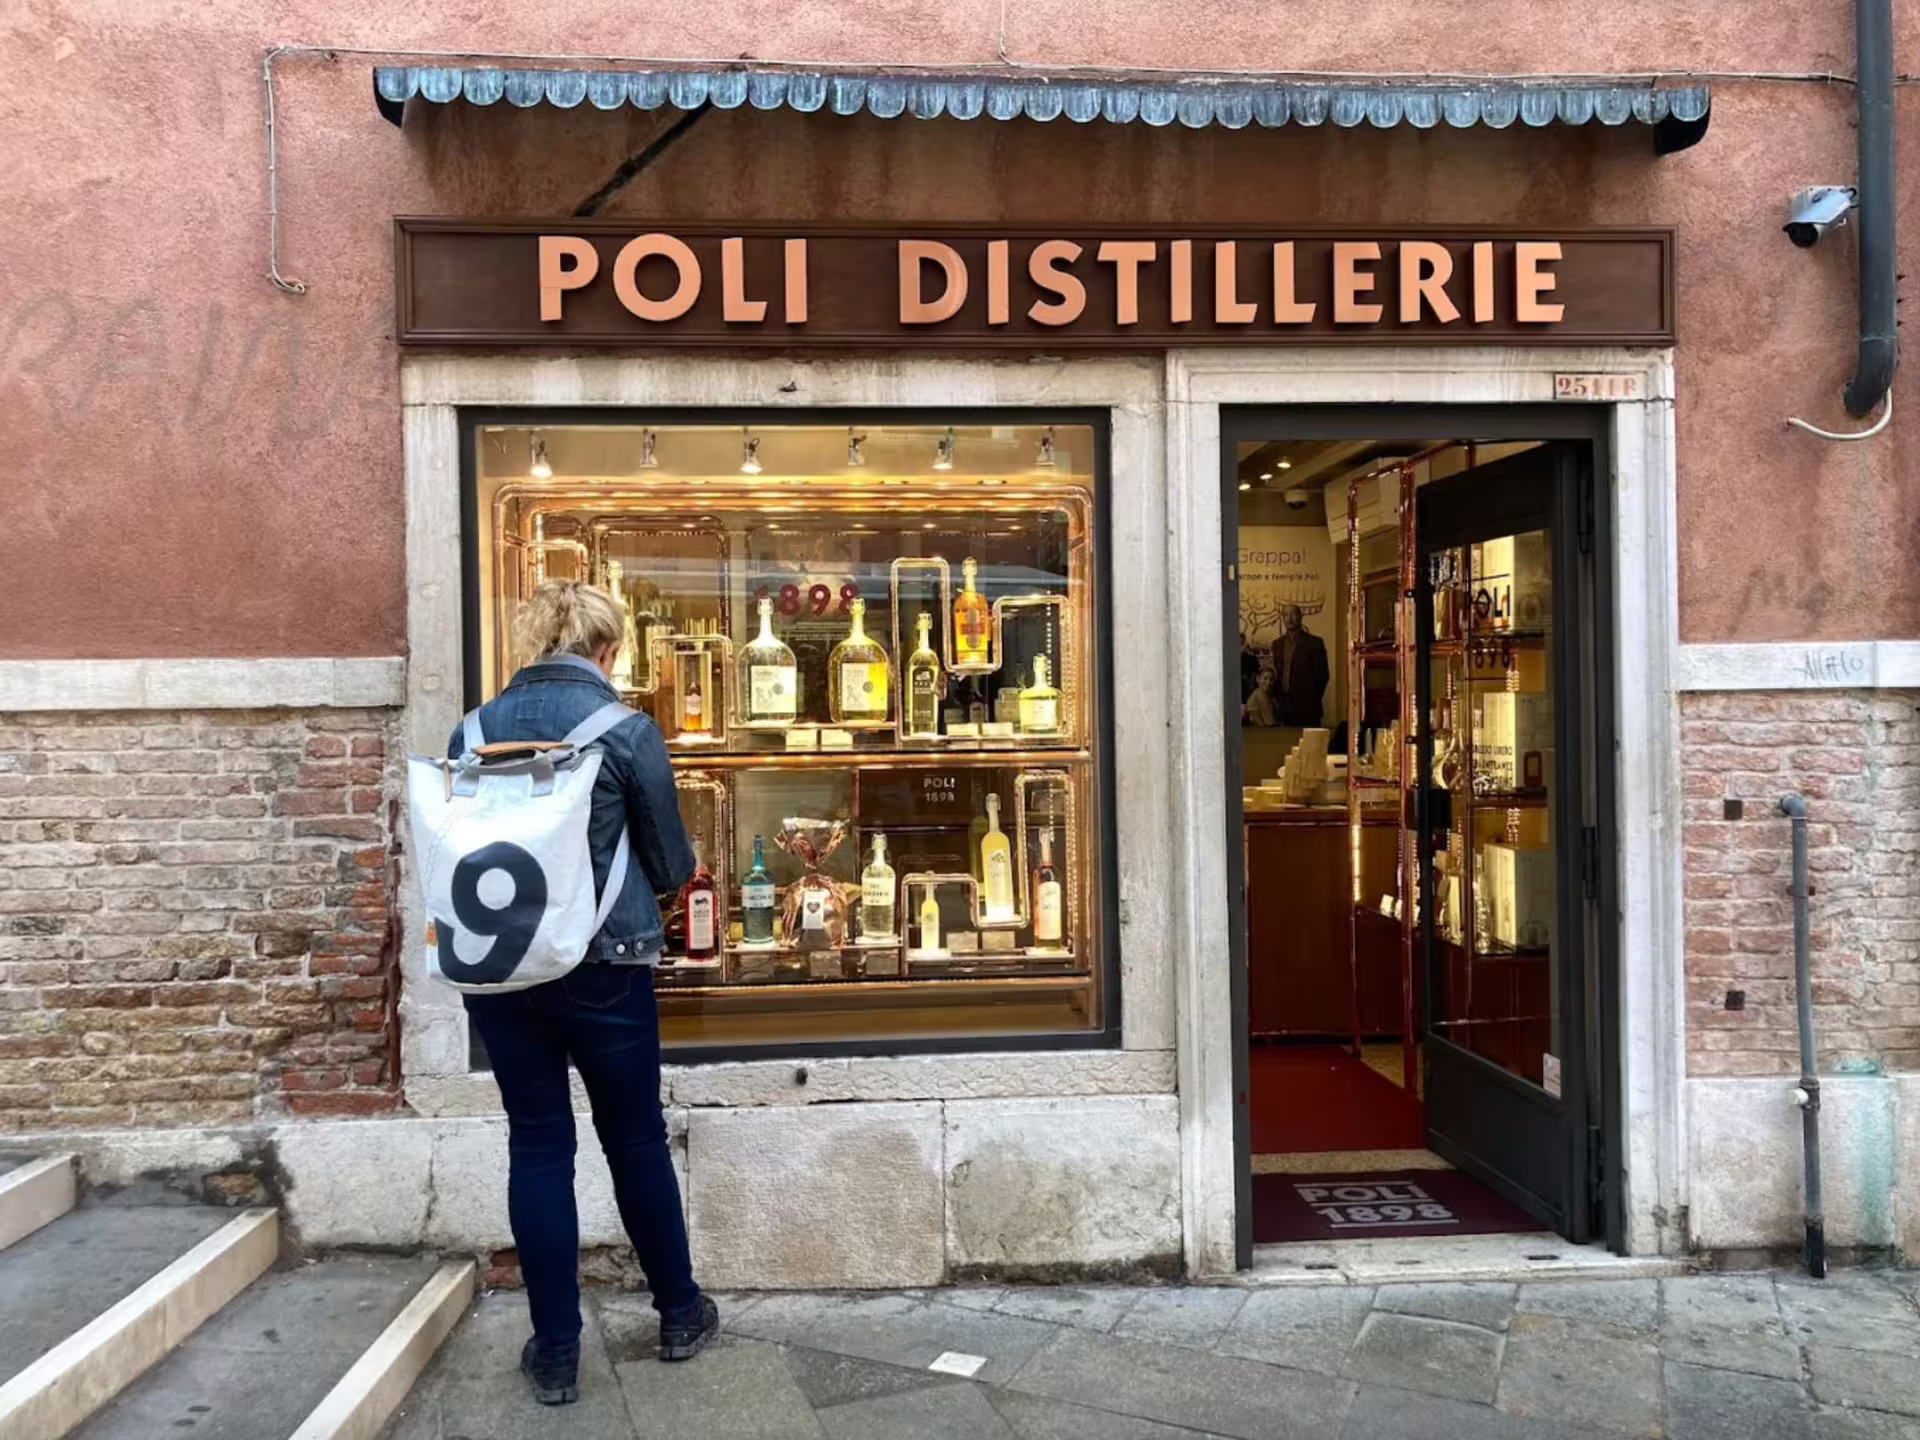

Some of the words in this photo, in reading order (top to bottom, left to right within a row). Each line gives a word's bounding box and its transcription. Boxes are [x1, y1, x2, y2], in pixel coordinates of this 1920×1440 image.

[539, 233, 807, 323] POLI
[898, 239, 1565, 326] DISTILLERIE
[1470, 585, 1511, 618] OLI
[923, 777, 956, 788] POLI
[435, 840, 548, 984] 9
[1297, 1185, 1429, 1202] POLI
[1316, 1203, 1454, 1223] 1898
